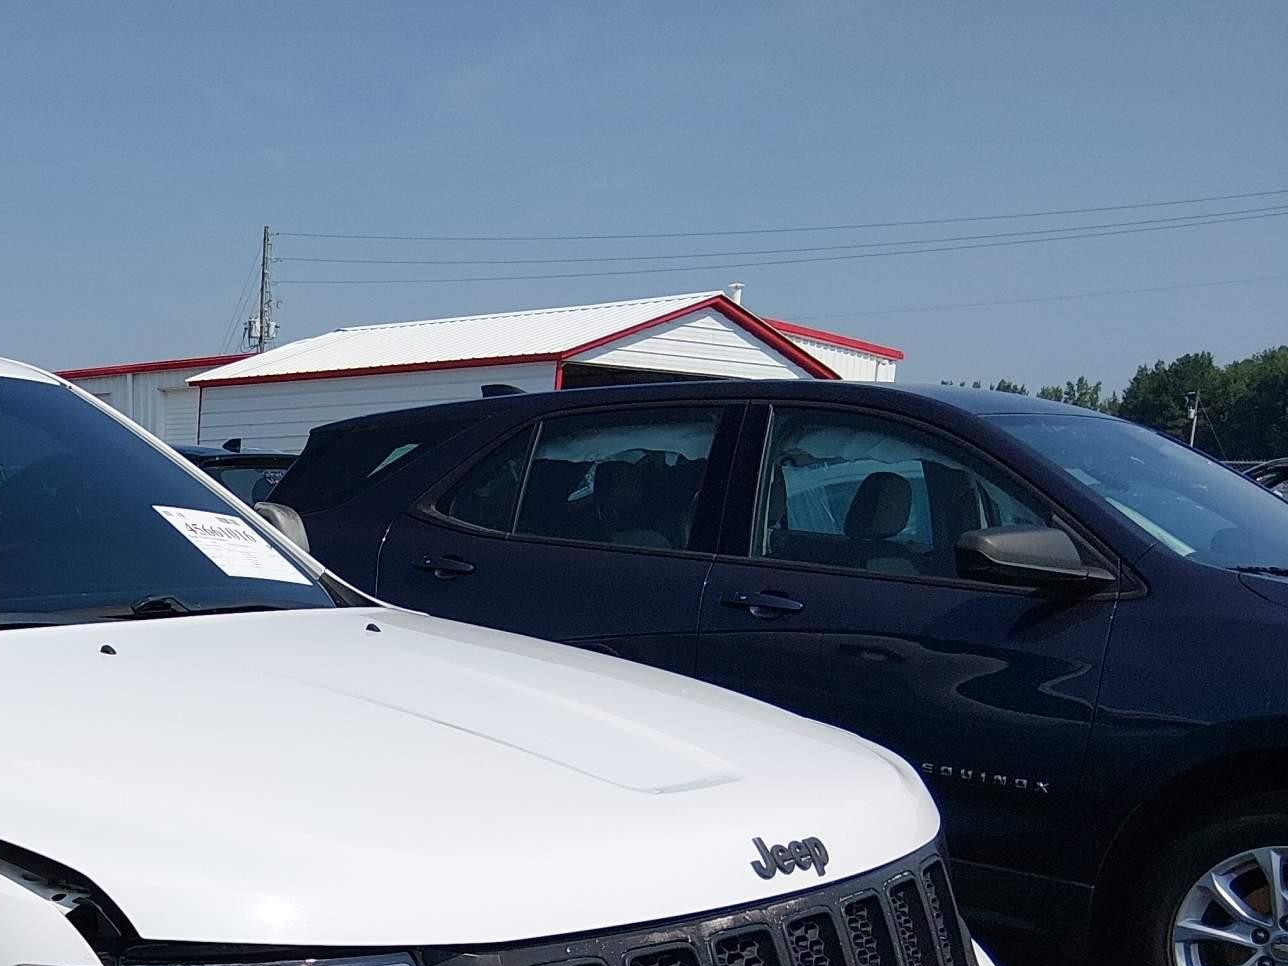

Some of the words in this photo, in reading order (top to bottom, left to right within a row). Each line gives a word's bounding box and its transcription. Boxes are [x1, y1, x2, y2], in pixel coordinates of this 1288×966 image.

[185, 522, 257, 543] 45661016
[921, 762, 1050, 793] EQUINOX
[750, 836, 829, 880] Jeep
